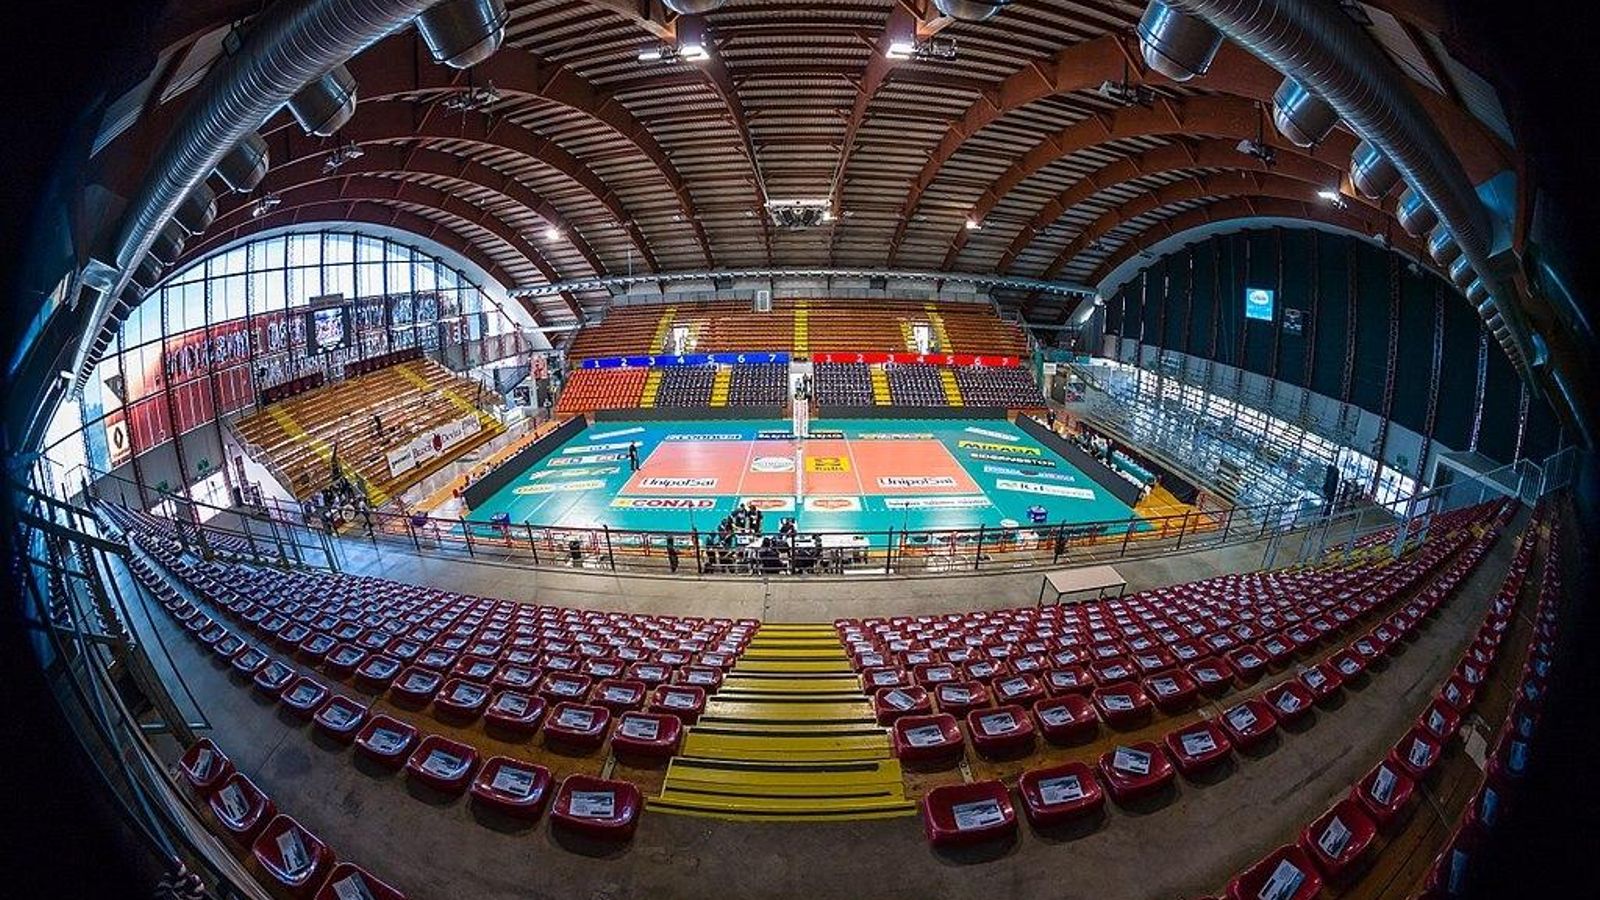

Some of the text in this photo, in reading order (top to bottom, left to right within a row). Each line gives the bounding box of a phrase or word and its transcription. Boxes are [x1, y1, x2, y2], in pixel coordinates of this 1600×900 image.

[594, 354, 776, 368] 1 2 3 4 5 6 7
[825, 354, 1009, 366] 1 2 3 4 5 6 7
[643, 477, 715, 487] UnipolSai
[880, 477, 954, 487] UnipolSai
[632, 499, 714, 508] CONAD
